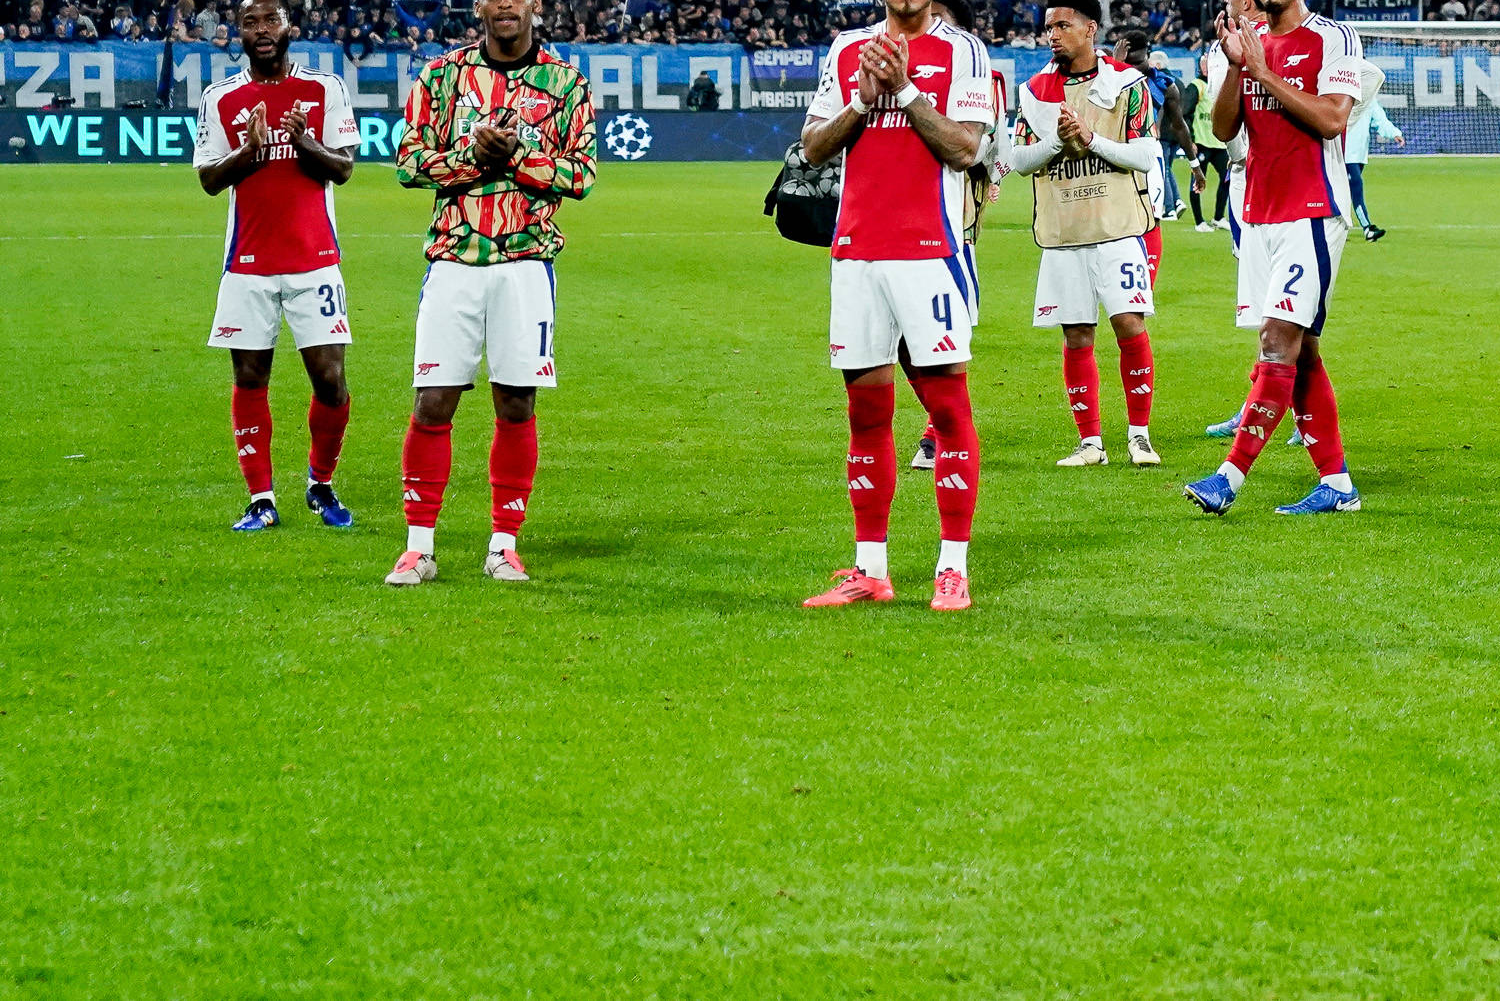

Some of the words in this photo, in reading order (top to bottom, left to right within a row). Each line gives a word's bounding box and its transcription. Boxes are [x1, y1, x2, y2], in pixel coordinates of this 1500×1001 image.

[753, 49, 814, 67] SEMPER
[0, 52, 116, 108] ZA
[966, 91, 987, 101] VISIT
[27, 115, 104, 157] WE
[1120, 262, 1148, 291] 53
[1283, 263, 1304, 296] 2
[931, 293, 953, 331] 4
[1129, 367, 1151, 376] AFC
[1249, 401, 1277, 419] AFC
[234, 425, 259, 436] AFC
[940, 450, 969, 460] AFC
